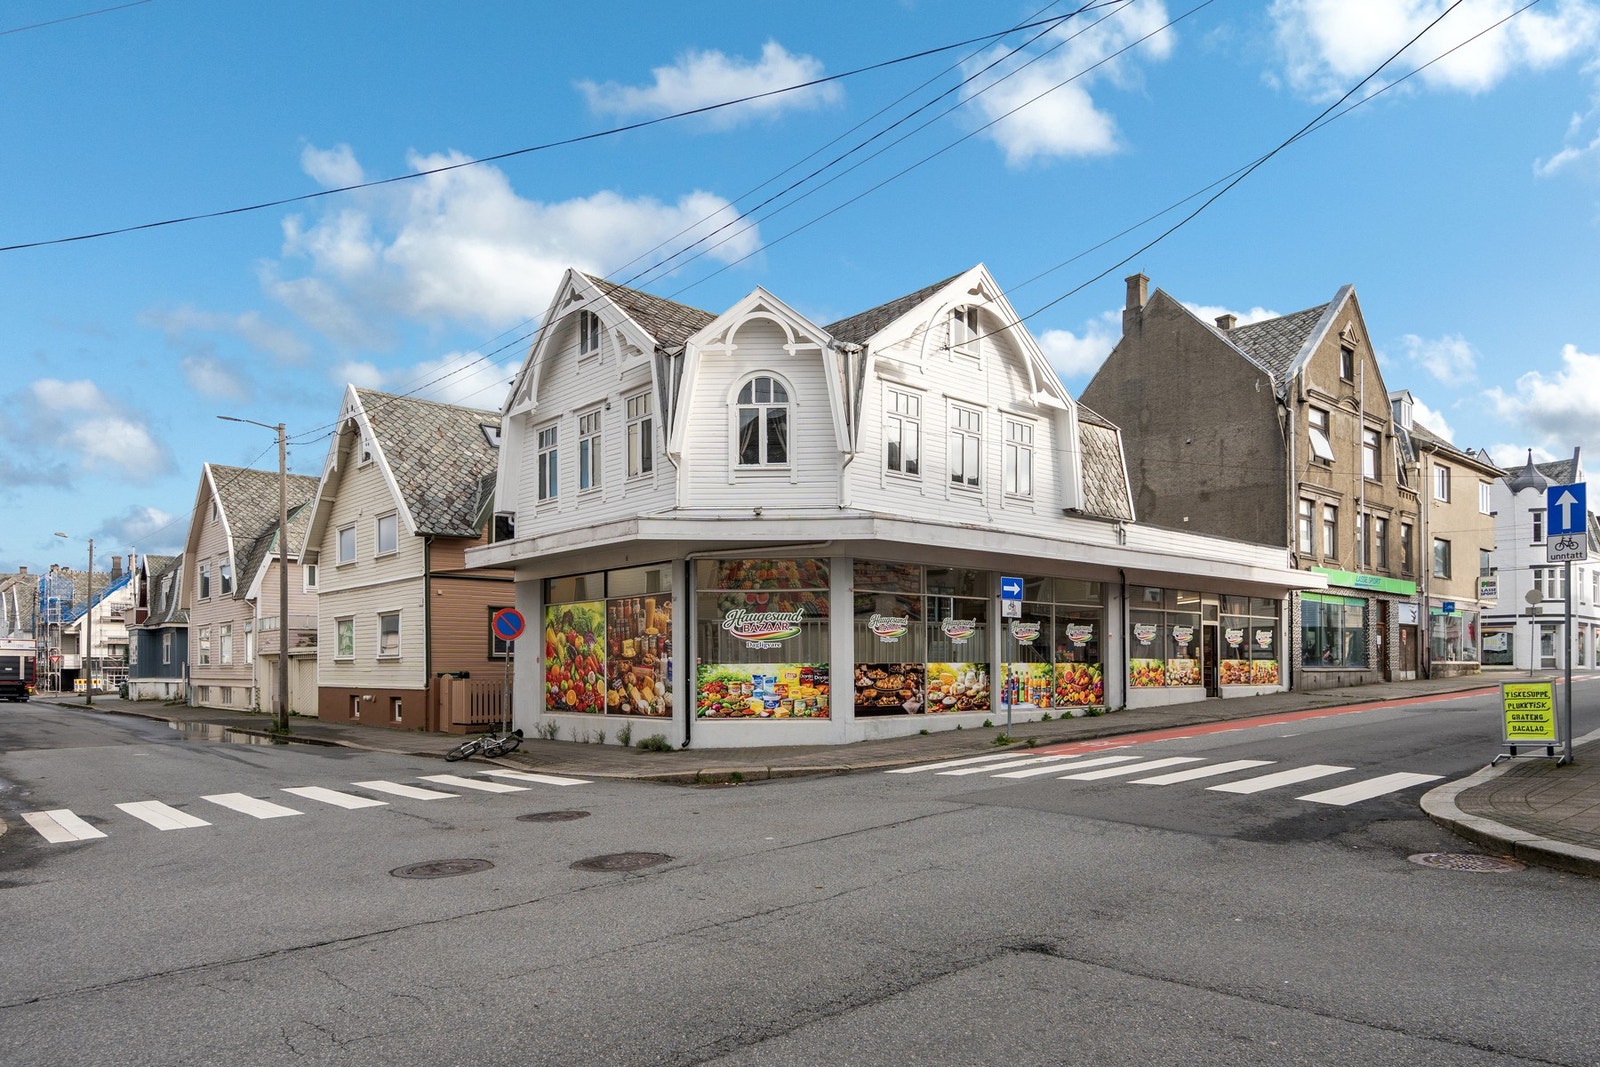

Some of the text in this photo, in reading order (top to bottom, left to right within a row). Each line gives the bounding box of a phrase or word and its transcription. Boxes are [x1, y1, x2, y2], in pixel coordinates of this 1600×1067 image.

[1550, 552, 1583, 560] unntatt
[722, 608, 804, 630] Haugesund
[743, 622, 789, 632] BAZAAR
[746, 641, 782, 649] Dagligvare
[1511, 713, 1544, 721] GRATENG
